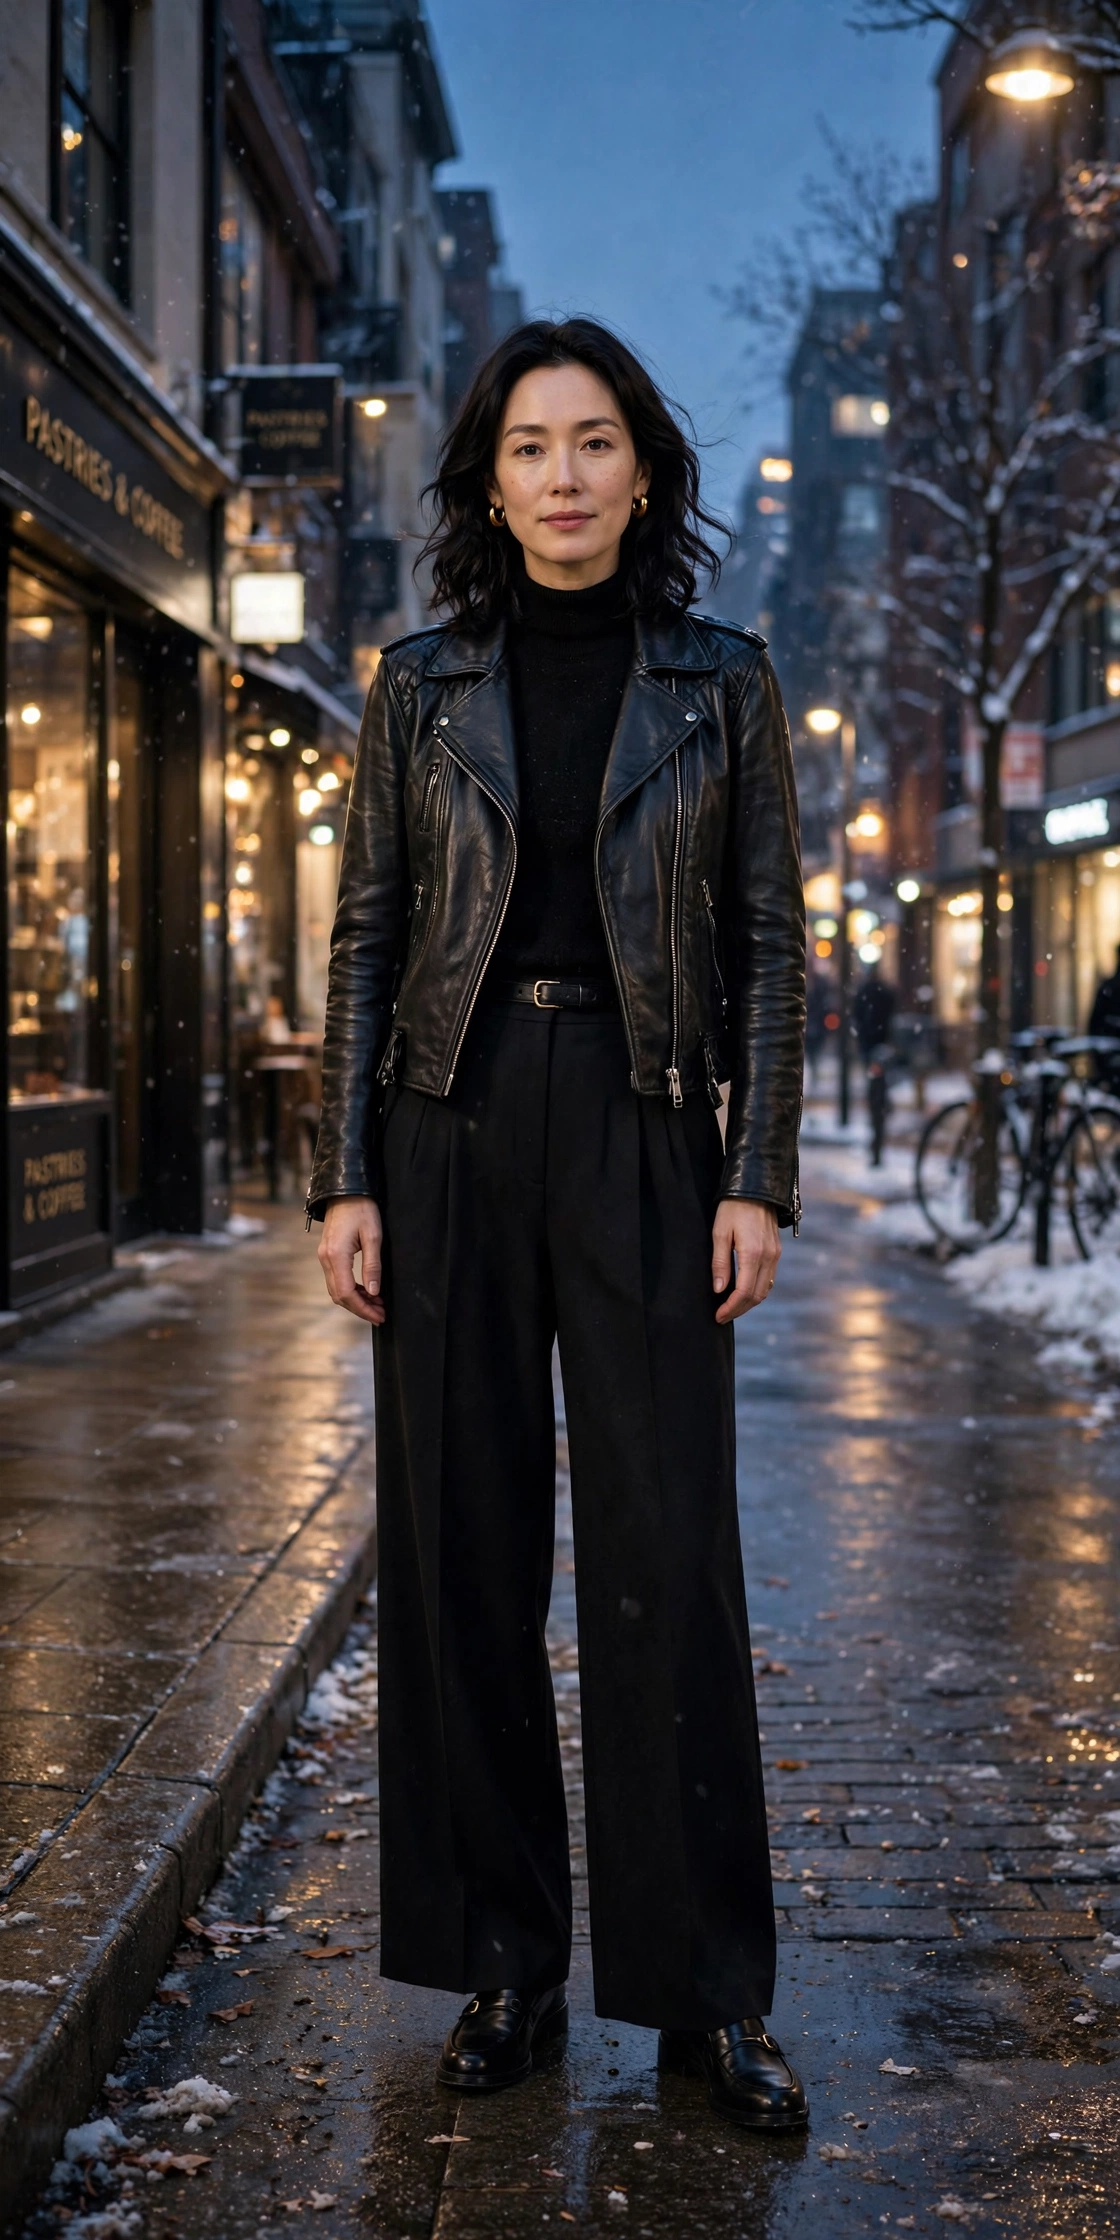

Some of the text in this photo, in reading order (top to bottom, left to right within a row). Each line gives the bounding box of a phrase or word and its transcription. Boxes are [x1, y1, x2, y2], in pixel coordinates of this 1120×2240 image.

[26, 394, 185, 560] PASTRIES & COFFEE
[24, 1148, 87, 1187] PASTRIES
[37, 1180, 86, 1221] COFFEE
